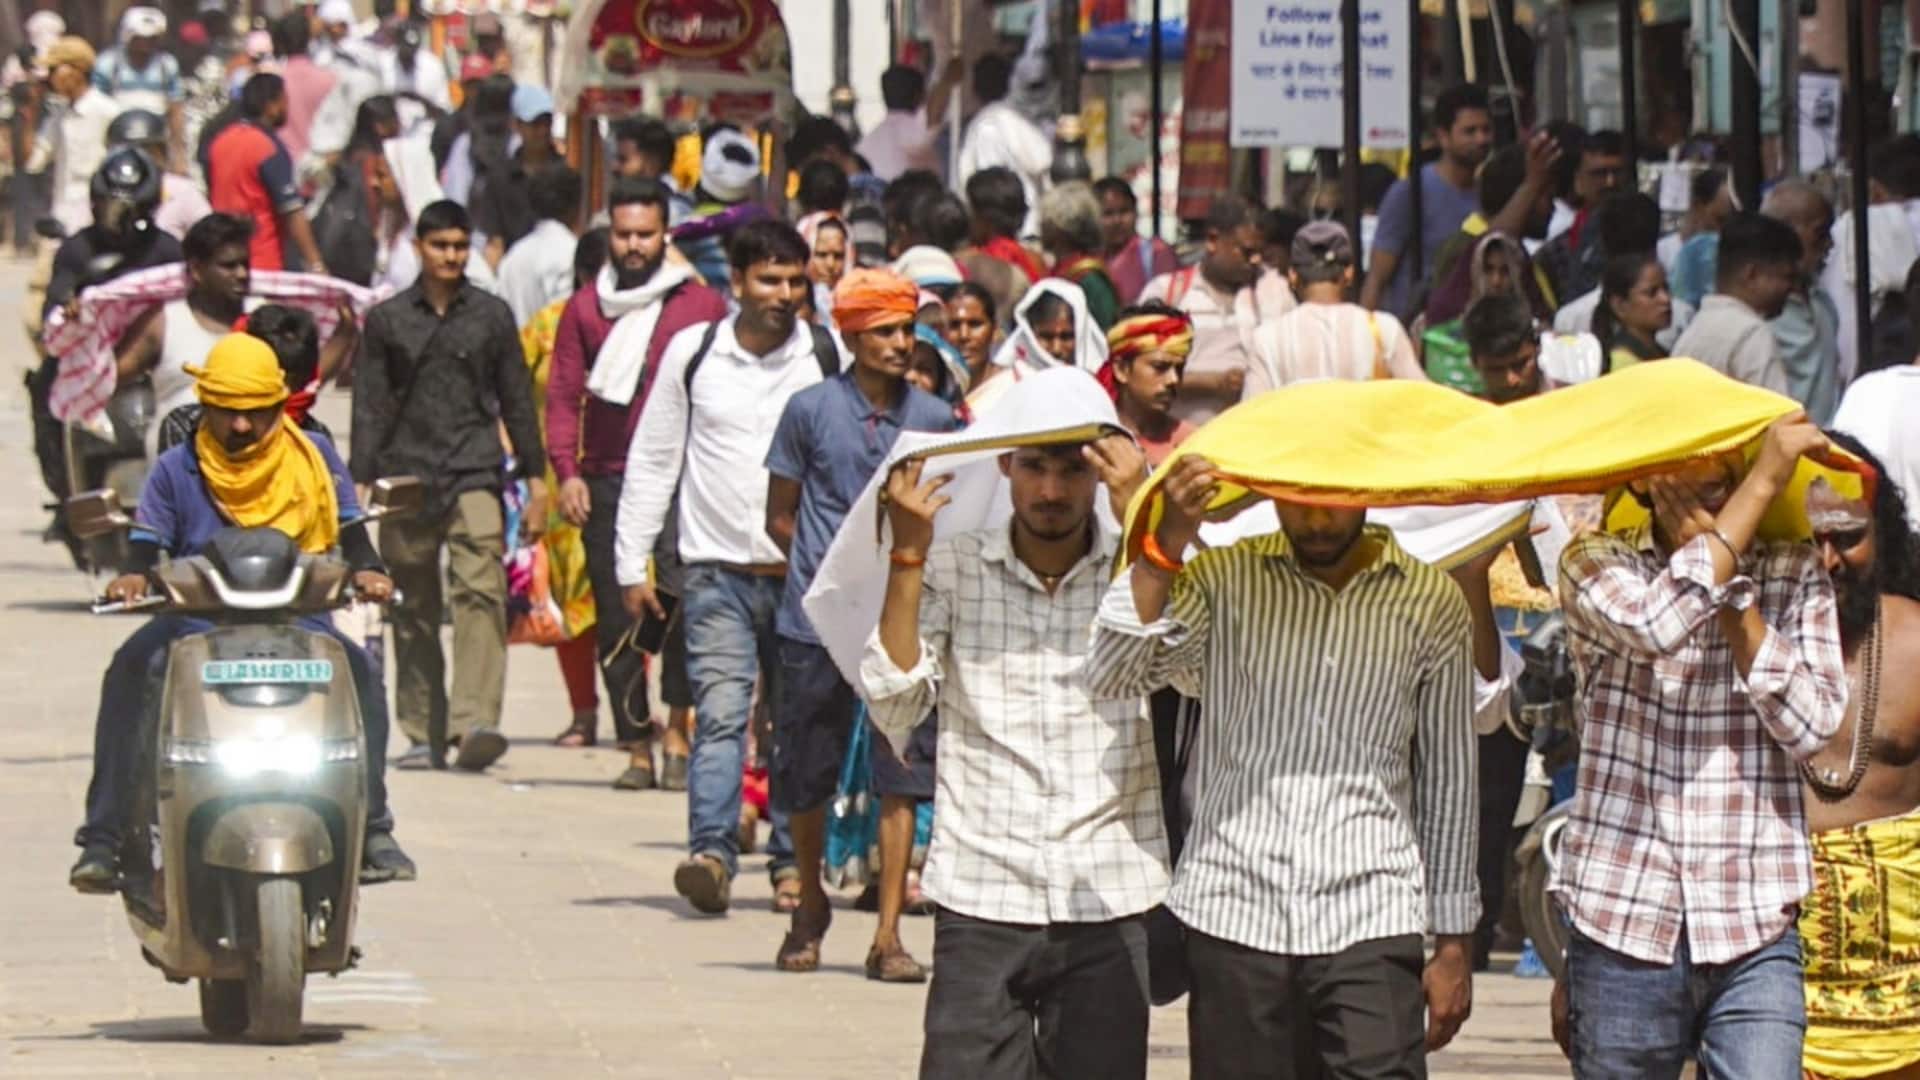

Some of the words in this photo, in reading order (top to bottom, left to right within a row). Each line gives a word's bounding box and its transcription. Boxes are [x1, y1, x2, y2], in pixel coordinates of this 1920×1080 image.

[1266, 6, 1332, 23] Follow
[1259, 30, 1301, 47] Line
[1307, 30, 1335, 47] for
